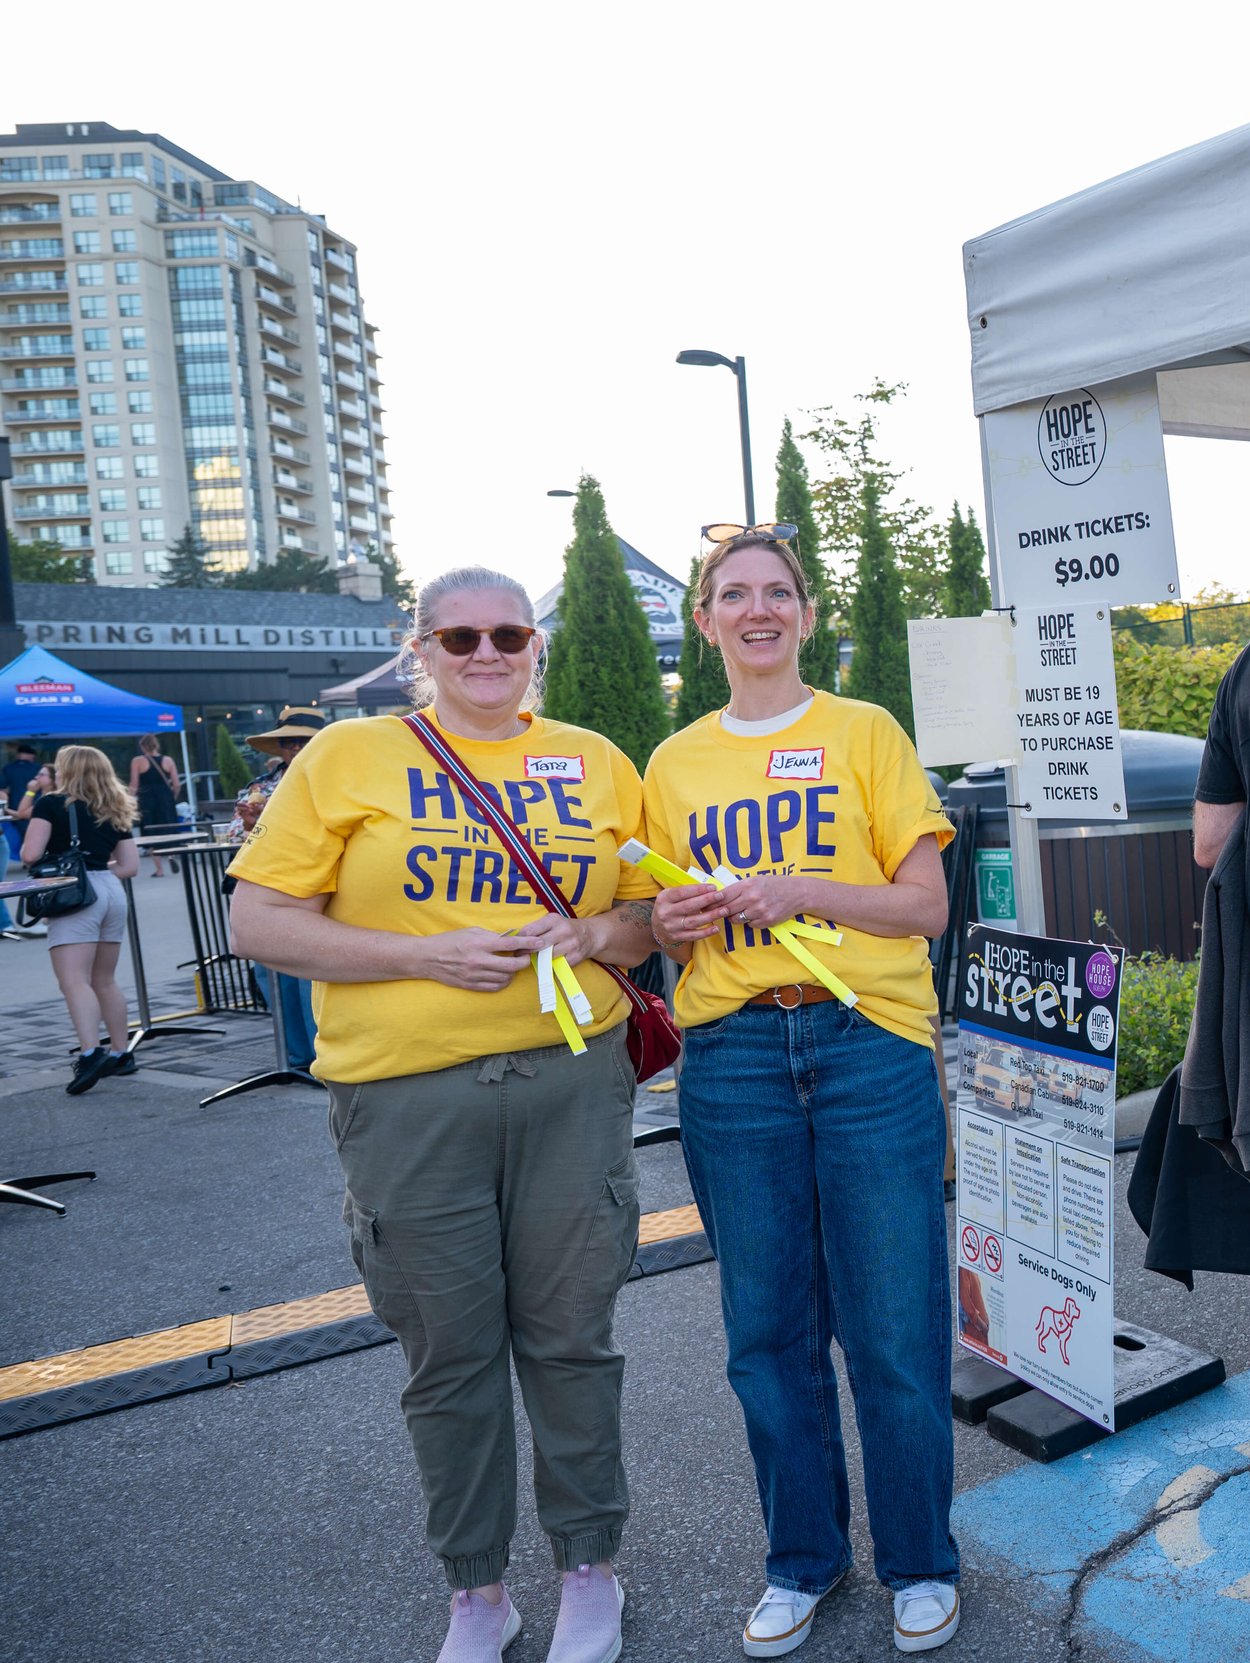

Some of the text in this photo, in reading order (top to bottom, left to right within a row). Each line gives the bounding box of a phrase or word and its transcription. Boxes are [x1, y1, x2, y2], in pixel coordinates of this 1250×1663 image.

[1046, 400, 1095, 442] HOPE
[1060, 436, 1085, 448] IN THE
[1051, 442, 1096, 471] STREET
[1018, 511, 1151, 549] DRINK TICKETS:
[1055, 553, 1120, 587] $9.00
[1037, 613, 1076, 640] HOPE
[263, 629, 404, 647] DISTILLE
[1040, 648, 1077, 667] STREET
[1025, 686, 1100, 702] MUST BE 19
[1017, 711, 1113, 727] YEARS OF AGE
[1021, 736, 1113, 751] TO PURCHASE
[773, 755, 820, 770] JENNA
[1048, 762, 1089, 776] DRINK
[407, 768, 592, 829] HOPE
[1043, 786, 1098, 800] TICKETS
[464, 826, 489, 844] IN
[689, 785, 838, 875] HOPE
[990, 943, 1065, 982] HOPE in the
[1092, 963, 1110, 976] HOPE
[966, 941, 1082, 1034] street
[1089, 973, 1112, 987] HOUSE
[1092, 1012, 1110, 1030] HOPE
[1091, 1030, 1109, 1044] STREET
[963, 1047, 979, 1058] Local
[963, 1064, 976, 1075] Taxi
[1010, 1057, 1045, 1076] Red Top Taxi
[1010, 1079, 1050, 1100] Canadian Cab
[1061, 1072, 1105, 1092] 519-821-1700
[1010, 1101, 1044, 1121] Guelph Taxi
[1061, 1095, 1104, 1116] 519-824-3110
[1063, 1119, 1104, 1140] 519-821-1414
[1018, 1253, 1097, 1301] Service Dogs Only
[1114, 1365, 1181, 1398] anopy.com
